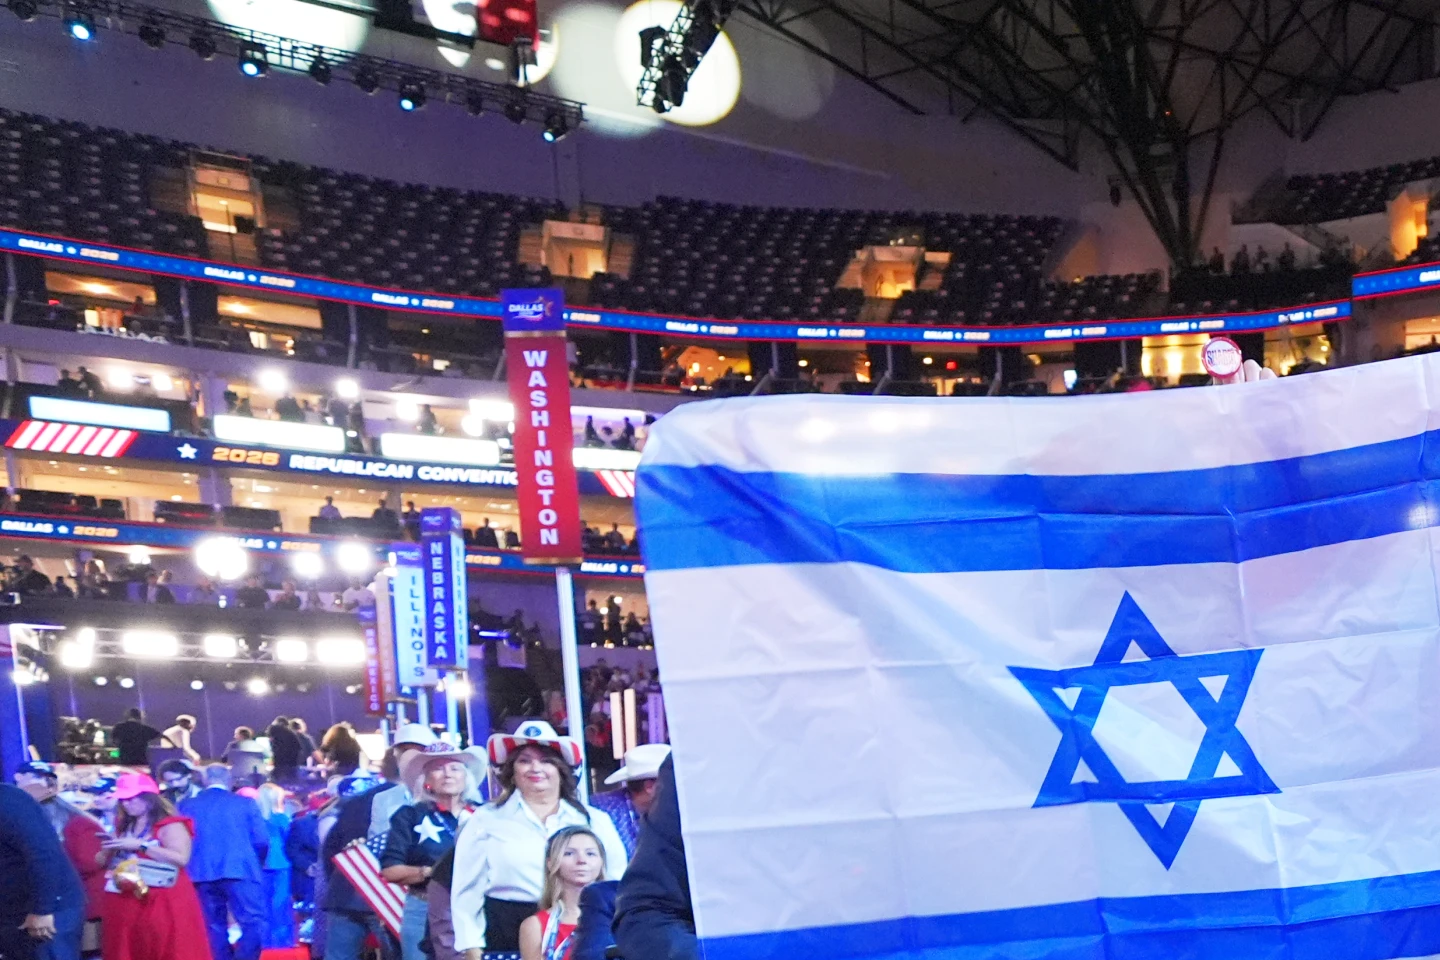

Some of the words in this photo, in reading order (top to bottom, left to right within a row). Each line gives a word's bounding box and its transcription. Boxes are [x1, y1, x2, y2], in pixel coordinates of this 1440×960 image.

[508, 303, 543, 313] DALLAS
[289, 454, 414, 479] REPUBLICAN
[417, 466, 518, 486] CONVENTIO
[523, 349, 559, 545] WASHINGTON
[1, 519, 53, 533] DALLAS
[409, 575, 425, 678] ILLINOIS
[430, 541, 448, 660] NEBRASKA
